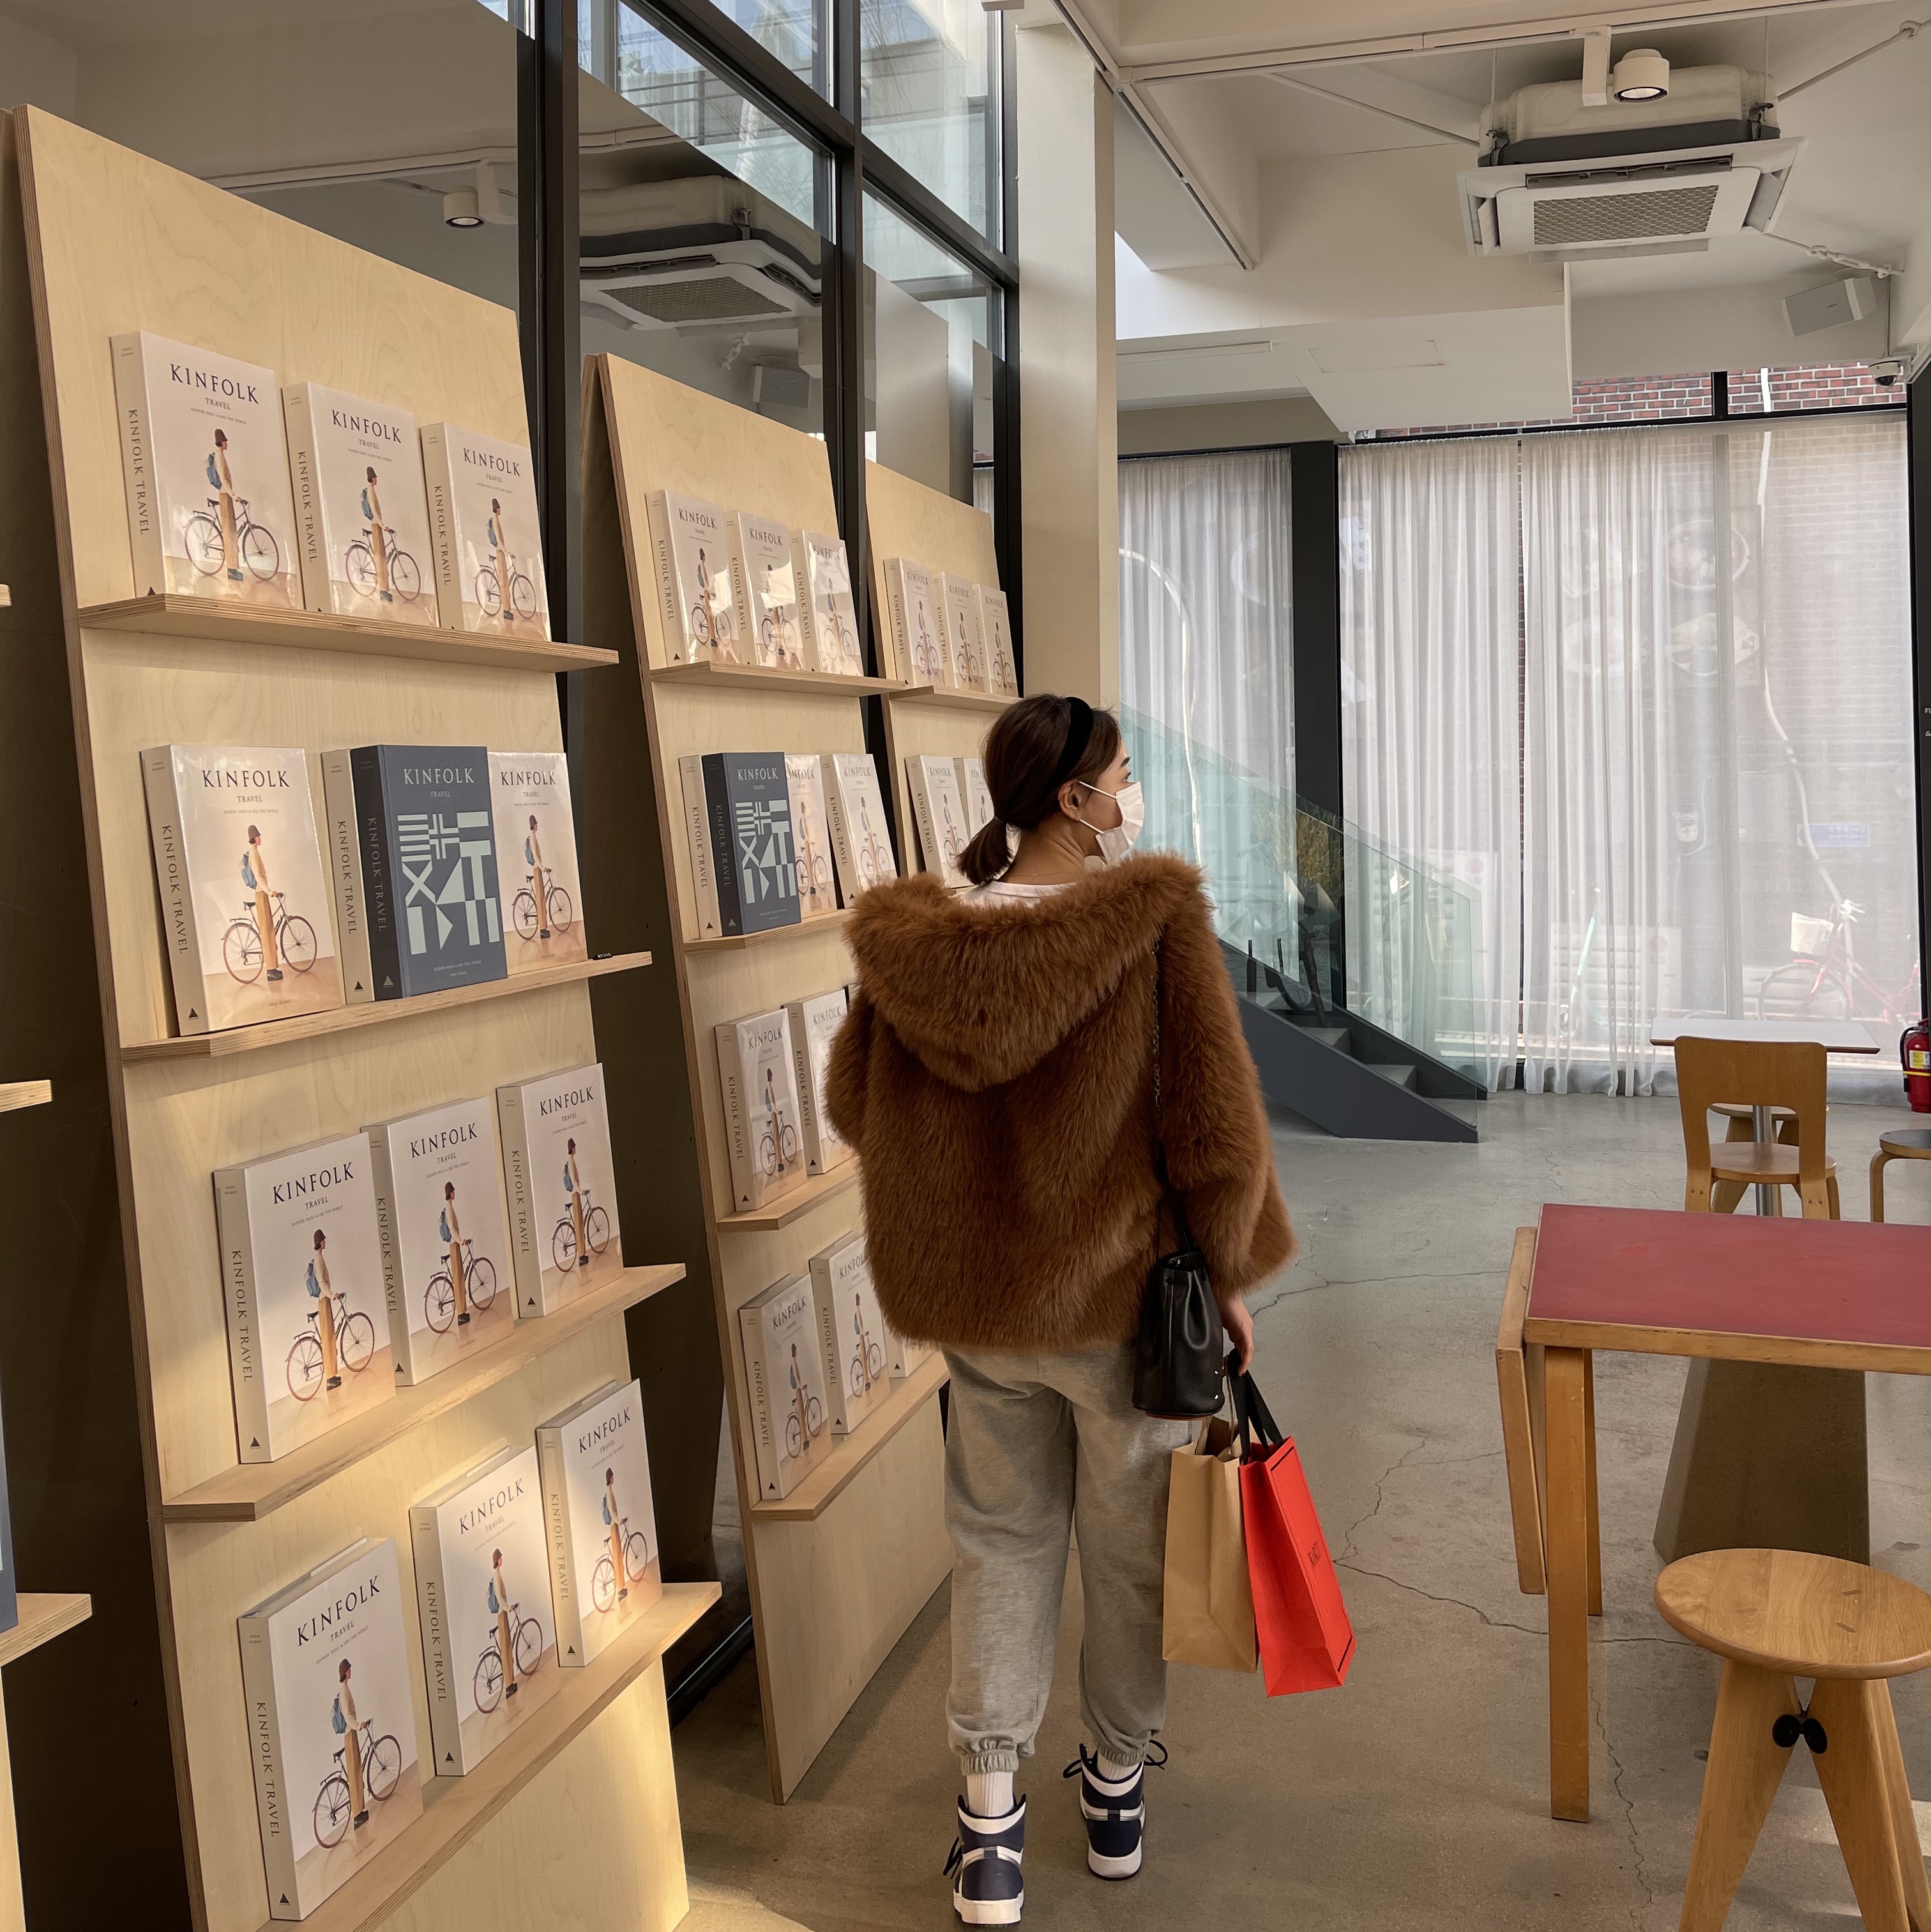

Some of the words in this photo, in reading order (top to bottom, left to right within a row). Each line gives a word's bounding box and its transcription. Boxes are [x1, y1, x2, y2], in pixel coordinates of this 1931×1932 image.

[170, 363, 259, 404] KINFOLK
[205, 398, 231, 411] TRAVEL
[128, 409, 144, 476] KINFOLK
[331, 409, 402, 444] KINFOLK
[359, 439, 379, 450] TRAVEL
[298, 451, 312, 510] KINFOLK
[463, 447, 520, 477] KINFOLK
[486, 474, 503, 483] TRAVEL
[135, 480, 149, 535] TRAVEL
[434, 485, 446, 538] KINFOLK
[678, 508, 716, 529] KINFOLK
[304, 514, 317, 563] TRAVEL
[749, 528, 783, 546] KINFOLK
[439, 541, 451, 585] TRAVEL
[658, 540, 670, 583] KINFOLK
[664, 585, 674, 621] TRAVEL
[731, 557, 743, 599] KINFOLK
[737, 599, 746, 632] TRAVEL
[797, 571, 806, 608] KINFOLK
[802, 610, 811, 641] TRAVEL
[936, 607, 945, 637] KINFOLK
[202, 770, 291, 788] KINFOLK
[403, 767, 475, 785] KINFOLK
[500, 771, 557, 786] KINFOLK
[737, 768, 778, 781] KINFOLK
[787, 769, 815, 780] INFOLK
[844, 767, 871, 777] KINFOLK
[716, 804, 727, 848] KINFOLK
[829, 797, 842, 833] KINFOLK
[837, 835, 848, 866] TRAVEL
[917, 793, 928, 825] KINFOLK
[925, 828, 934, 853] TRAVEL
[367, 817, 382, 878] KINFOLK
[692, 806, 703, 850] KINFOLK
[698, 853, 708, 889] TRAVEL
[721, 851, 731, 887] TRAVEL
[162, 825, 180, 893] KINFOLK
[173, 898, 188, 955] TRAVEL
[337, 820, 352, 881] KINFOLK
[345, 885, 358, 935] TRAVEL
[374, 882, 387, 932] TRAVEL
[813, 1006, 841, 1025] KINFOLK
[748, 1027, 783, 1050] KINFOLK
[796, 1050, 807, 1091] KINFOLK
[540, 1086, 594, 1116] KINFOLK
[561, 1112, 577, 1123] TRAVEL
[728, 1076, 739, 1121] KINFOLK
[801, 1093, 811, 1128] TRAVEL
[410, 1122, 478, 1159] KINFOLK
[436, 1152, 457, 1165] TRAVEL
[733, 1124, 743, 1160] TRAVEL
[272, 1161, 354, 1206] KINFOLK
[511, 1150, 524, 1206] KINFOLK
[304, 1196, 329, 1210] TRAVEL
[377, 1197, 392, 1259] KINFOLK
[517, 1209, 529, 1254] TRAVEL
[232, 1250, 248, 1319] KINFOLK
[839, 1254, 865, 1279] KINFOL
[384, 1264, 398, 1314] TRAVEL
[772, 1295, 806, 1329] KINFOLK
[239, 1325, 253, 1382] TRAVEL
[822, 1307, 832, 1350] KINFOLK
[827, 1352, 837, 1386] TRAVEL
[753, 1361, 764, 1406] KINFOLK
[578, 1407, 631, 1454] KINFOLK
[599, 1439, 615, 1454] TRAVEL
[758, 1411, 769, 1447] TRAVEL
[459, 1478, 524, 1535] KINFOLK
[485, 1515, 504, 1533] TRAVEL
[551, 1493, 564, 1551] KINFOLK
[557, 1555, 569, 1601] TRAVEL
[297, 1575, 381, 1647] KINFOLK
[329, 1620, 355, 1642] TRAVEL
[426, 1581, 441, 1646] KINFOLK
[433, 1651, 446, 1703] TRAVEL
[257, 1701, 273, 1773] KINFOLK
[265, 1779, 279, 1837] TRAVEL
